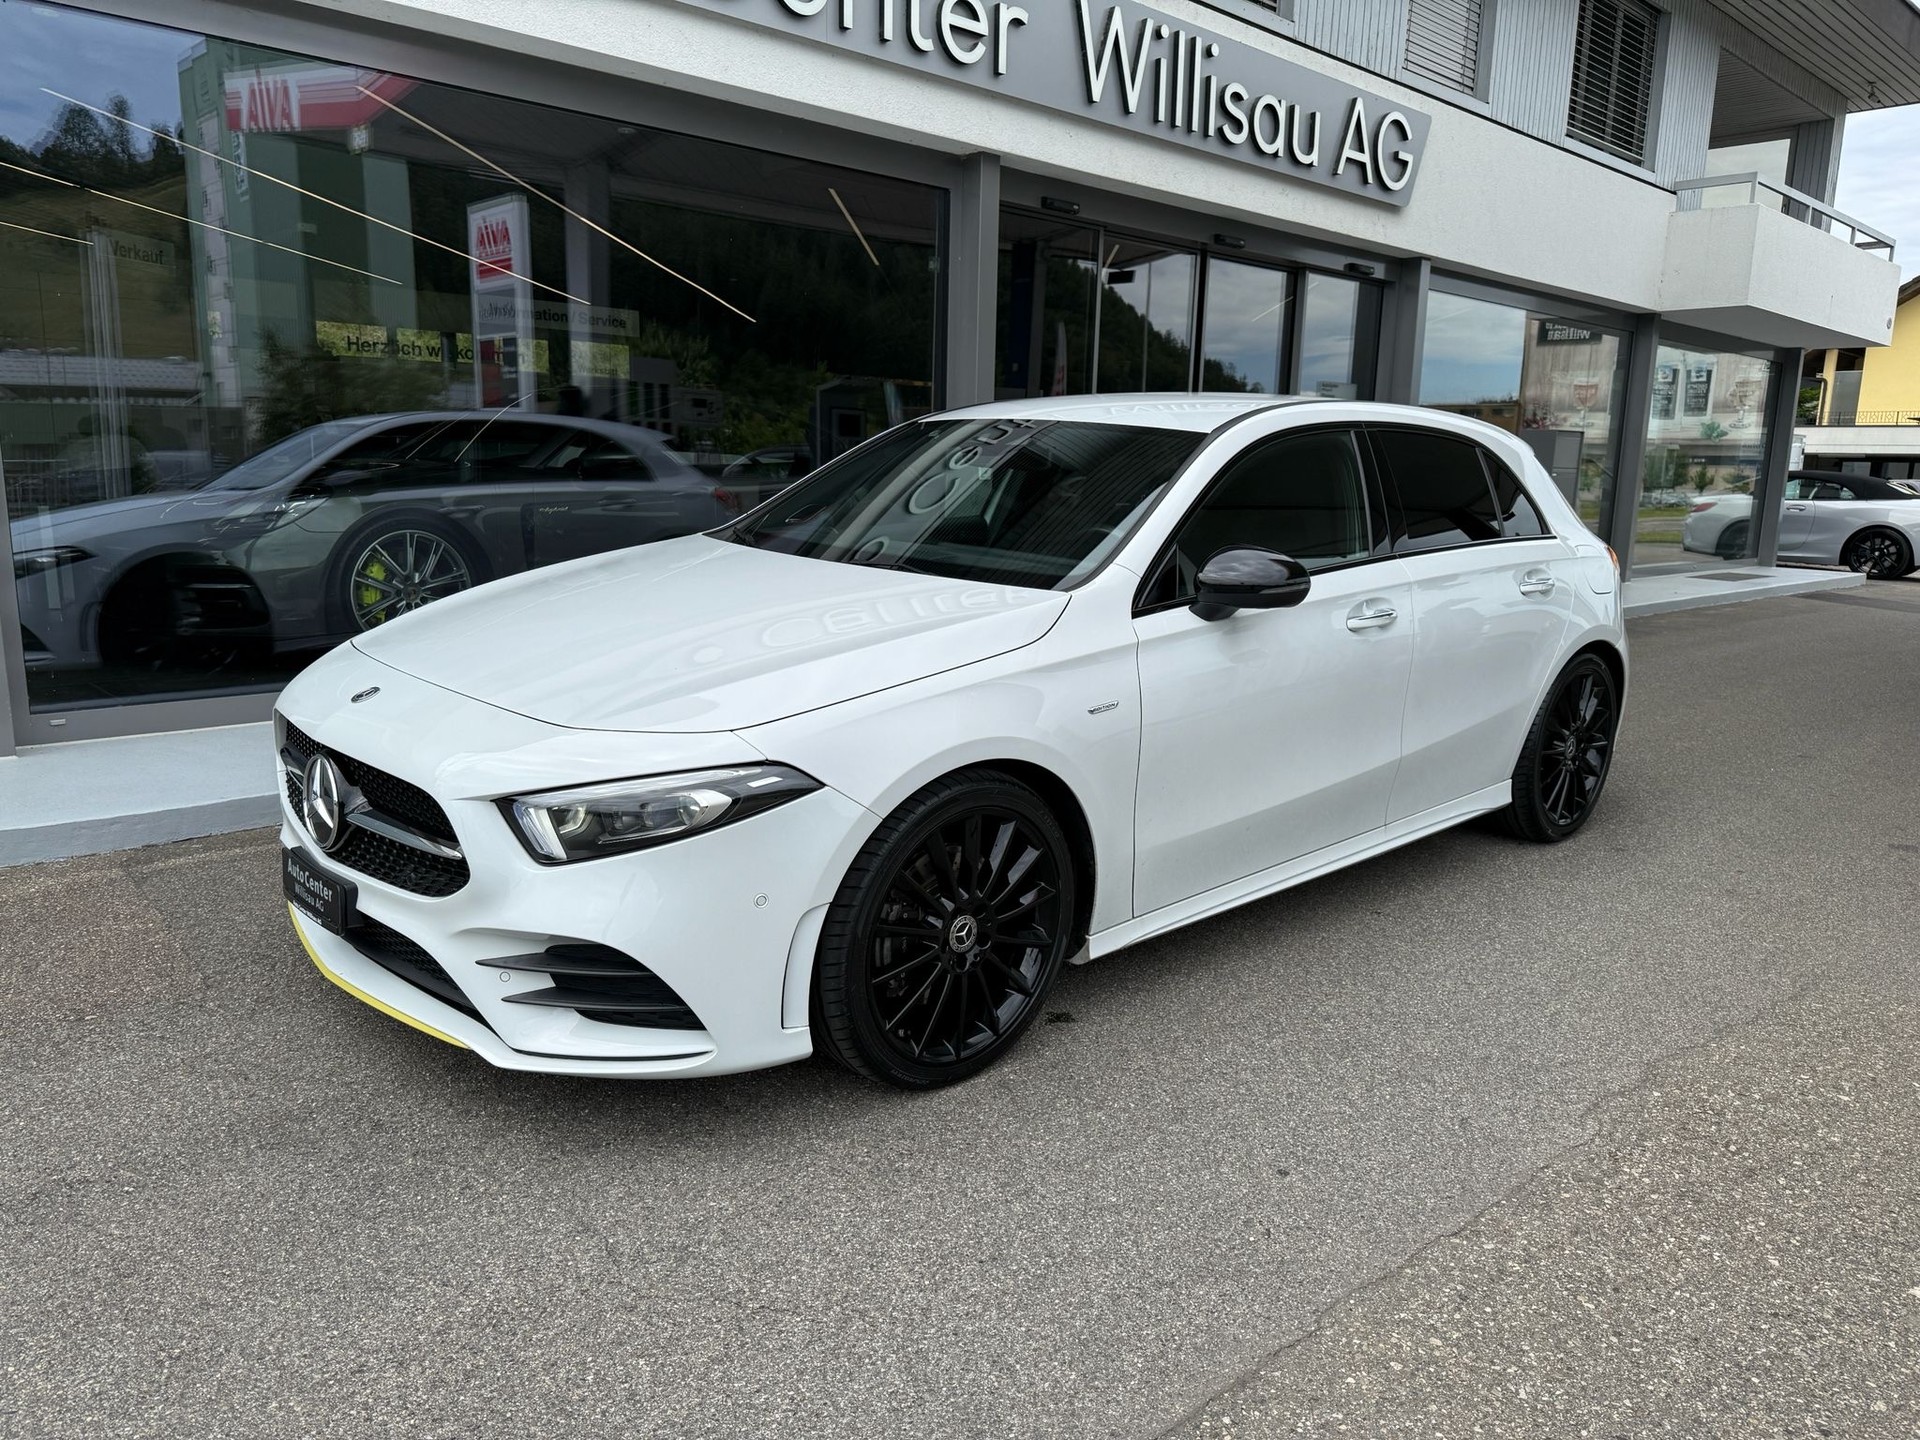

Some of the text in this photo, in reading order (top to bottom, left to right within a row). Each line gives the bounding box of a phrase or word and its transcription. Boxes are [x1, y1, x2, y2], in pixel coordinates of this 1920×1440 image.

[1077, 0, 1321, 167] Willisau
[1333, 97, 1414, 191] AG
[109, 239, 165, 265] Verkauf
[578, 311, 627, 330] Service
[315, 897, 325, 913] AG
